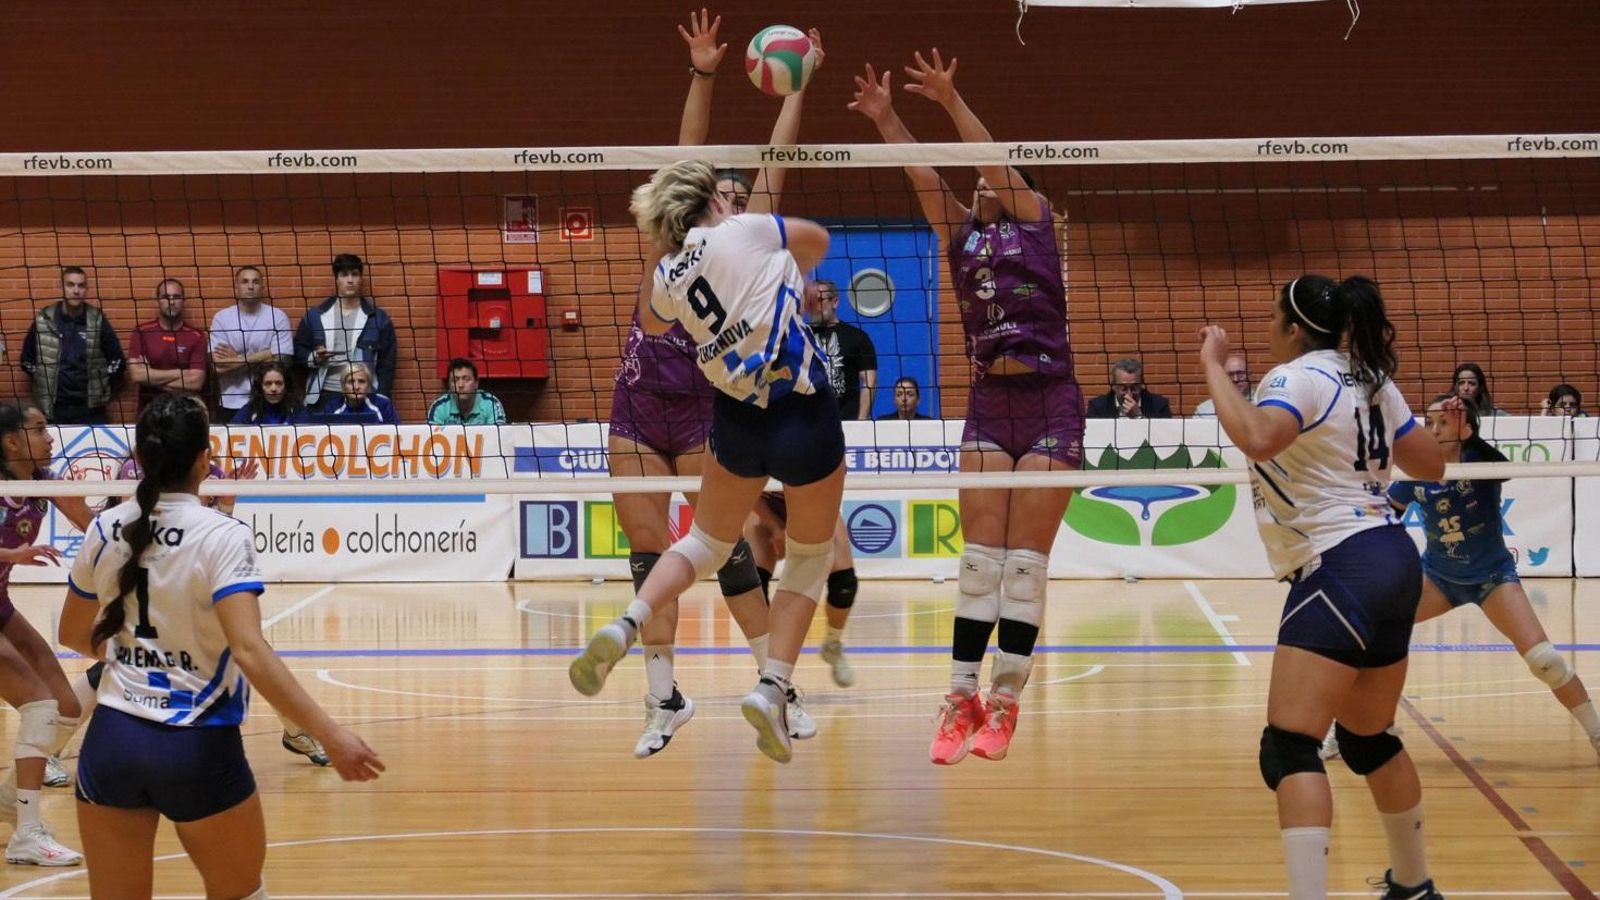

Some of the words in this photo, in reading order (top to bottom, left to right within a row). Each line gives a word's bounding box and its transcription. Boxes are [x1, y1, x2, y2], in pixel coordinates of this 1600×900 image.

[1257, 140, 1349, 155] rfevb.com
[1507, 136, 1598, 151] rfevb.com
[268, 152, 358, 168] rfevb.com
[513, 149, 604, 164] rfevb.com
[760, 147, 851, 162] rfevb.com
[1008, 145, 1100, 160] rfevb.com
[24, 154, 113, 170] rfevb.com
[975, 267, 997, 300] 3
[686, 275, 728, 337] 9
[1353, 404, 1390, 472] 14
[558, 448, 609, 470] CLU
[864, 448, 960, 469] BENIDO
[1437, 515, 1461, 533] 15
[346, 513, 477, 554] colchonería
[132, 566, 159, 639] 1
